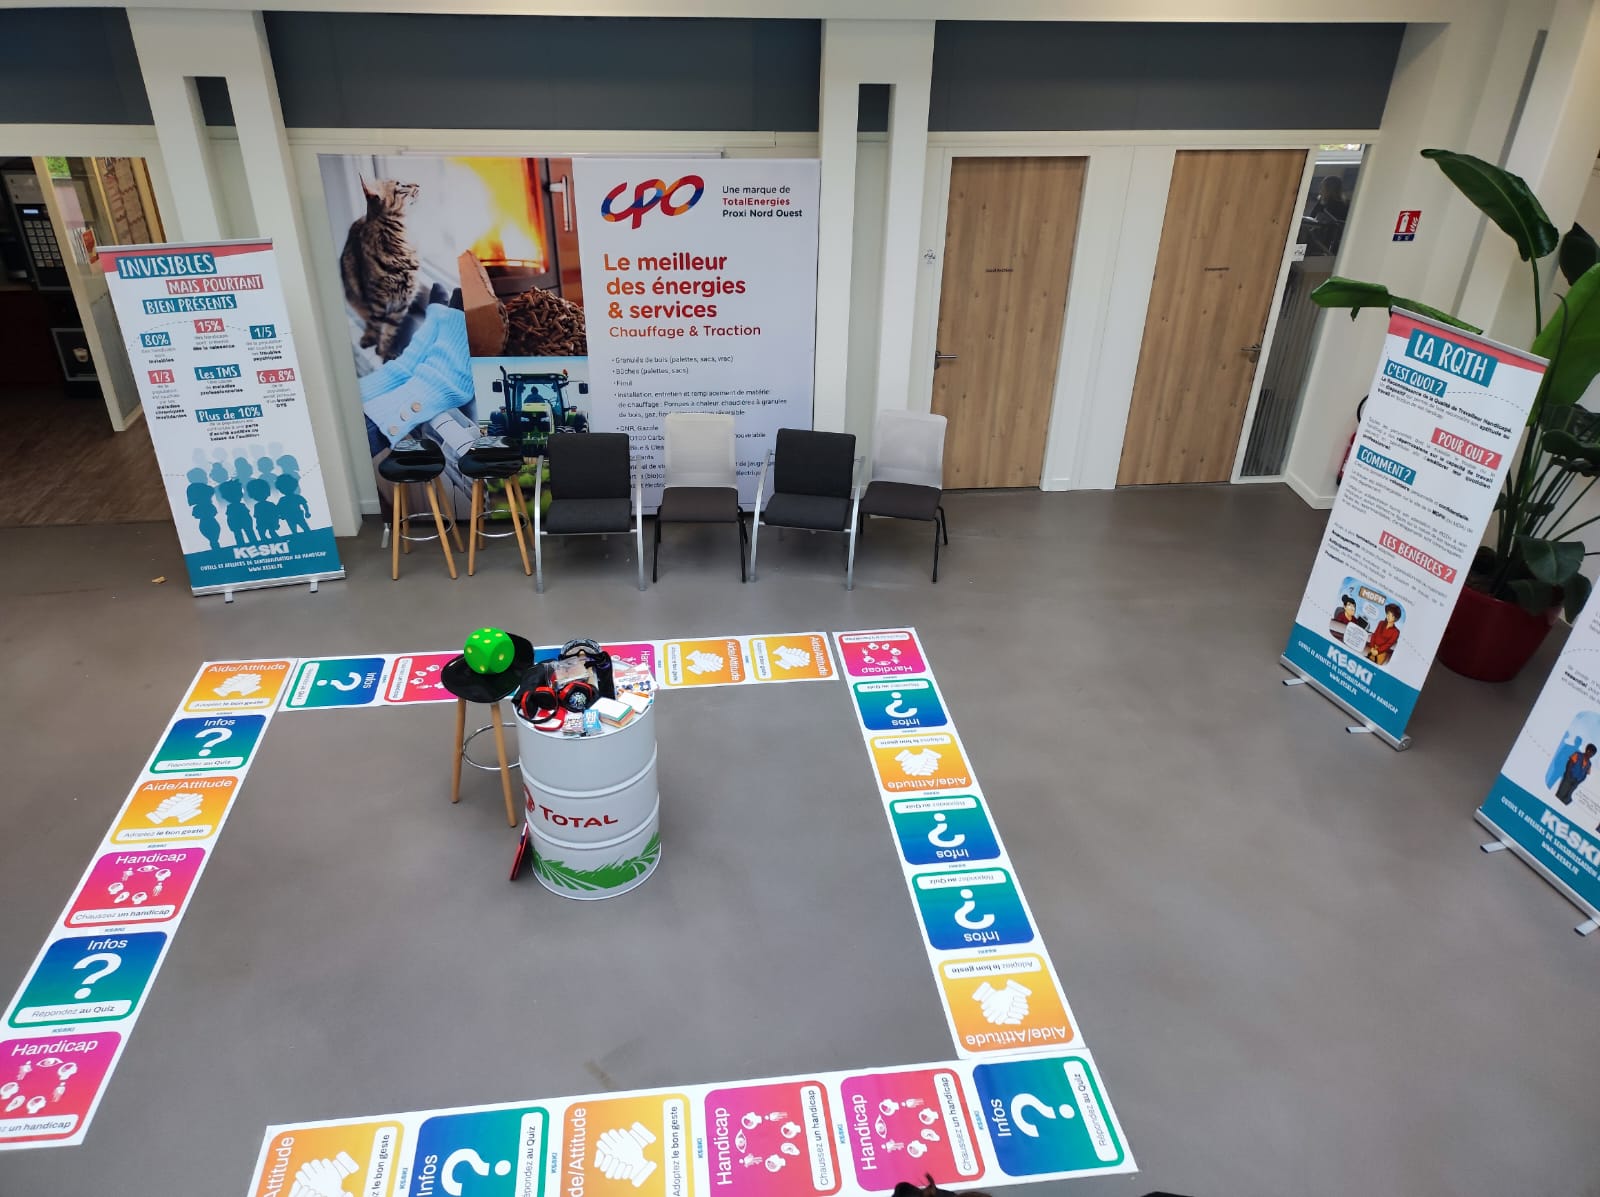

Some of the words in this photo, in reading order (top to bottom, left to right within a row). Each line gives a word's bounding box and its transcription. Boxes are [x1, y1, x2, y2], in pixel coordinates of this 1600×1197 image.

[722, 186, 741, 194] Une
[742, 186, 777, 195] marque
[779, 185, 791, 194] de
[722, 197, 790, 208] TotalEnergies
[722, 209, 747, 217] Proxi
[749, 209, 773, 217] Nord
[776, 209, 803, 217] Ouest
[118, 254, 215, 277] INVISIBLES
[604, 253, 630, 271] Le
[638, 252, 727, 271] meilleur
[168, 279, 200, 293] MAIS
[203, 276, 262, 292] POURTANT
[606, 277, 646, 295] des
[652, 276, 746, 298] énergies
[146, 300, 175, 314] BIEN
[178, 295, 235, 312] PRÉSENTS
[608, 301, 623, 319] &
[629, 301, 717, 319] services
[197, 320, 222, 332] 15%
[254, 327, 272, 338] 1/5
[609, 325, 685, 339] Chauffage
[689, 325, 699, 337] &
[703, 325, 761, 337] Traction
[144, 334, 169, 345] 80%
[1413, 334, 1435, 362] LA
[1438, 342, 1488, 382] RQTH
[152, 372, 171, 383] 1/3
[216, 365, 238, 378] TMS
[259, 374, 265, 383] 6
[278, 371, 294, 381] 8%
[1387, 362, 1409, 378] C'EST
[1410, 370, 1435, 391] QUOI
[1435, 381, 1444, 394] ?
[199, 410, 220, 422] Plus
[223, 409, 235, 420] de
[238, 406, 261, 417] 10%
[1437, 432, 1463, 453] POUR
[1464, 442, 1485, 464] QUI
[1486, 451, 1495, 466] ?
[1361, 449, 1404, 477] COMMENT
[1404, 469, 1412, 481] ?
[233, 542, 290, 559] KESKI
[1383, 534, 1396, 551] LES
[1398, 542, 1443, 578] BÉNÉFICES
[1444, 568, 1453, 580] ?
[1362, 588, 1386, 605] MDPH
[208, 663, 286, 673] Aide/Attitude
[861, 665, 913, 674] Handicap
[1327, 645, 1374, 686] KESKI
[363, 672, 377, 689] Infos
[204, 718, 236, 727] Infos
[891, 718, 920, 727] Infos
[142, 779, 233, 792] Aide/Attitude
[888, 776, 967, 790] Aide/Attitude
[539, 804, 618, 828] TOTAL
[115, 852, 187, 865] Handicap
[936, 849, 969, 859] Infos
[129, 908, 170, 917] handicap
[87, 939, 128, 951] Infos
[963, 931, 1000, 943] Infos
[32, 1007, 78, 1018] Répondez
[93, 1005, 115, 1014] Quiz
[966, 1026, 1066, 1047] Aide/Attitude
[11, 1040, 98, 1057] Handicap
[1074, 1073, 1086, 1092] Quiz
[941, 1077, 957, 1115] handicap
[1082, 1093, 1091, 1104] au
[808, 1090, 820, 1129] handicap
[990, 1098, 1012, 1137] Infos
[23, 1119, 71, 1132] handicap
[670, 1106, 680, 1131] geste
[952, 1116, 960, 1128] un
[1087, 1104, 1108, 1147] Répondez
[527, 1125, 536, 1146] Quiz
[671, 1132, 679, 1149] bon
[814, 1130, 822, 1142] un
[852, 1094, 877, 1171] Handicap
[380, 1134, 390, 1159] geste
[526, 1148, 534, 1159] au
[671, 1150, 680, 1159] le
[714, 1107, 733, 1186] Handicap
[955, 1128, 972, 1171] Chaussez
[373, 1161, 385, 1180] bon
[816, 1143, 829, 1186] Chaussez
[417, 1154, 438, 1197] Infos
[672, 1160, 682, 1197] Adoptez
[371, 1180, 381, 1190] le
